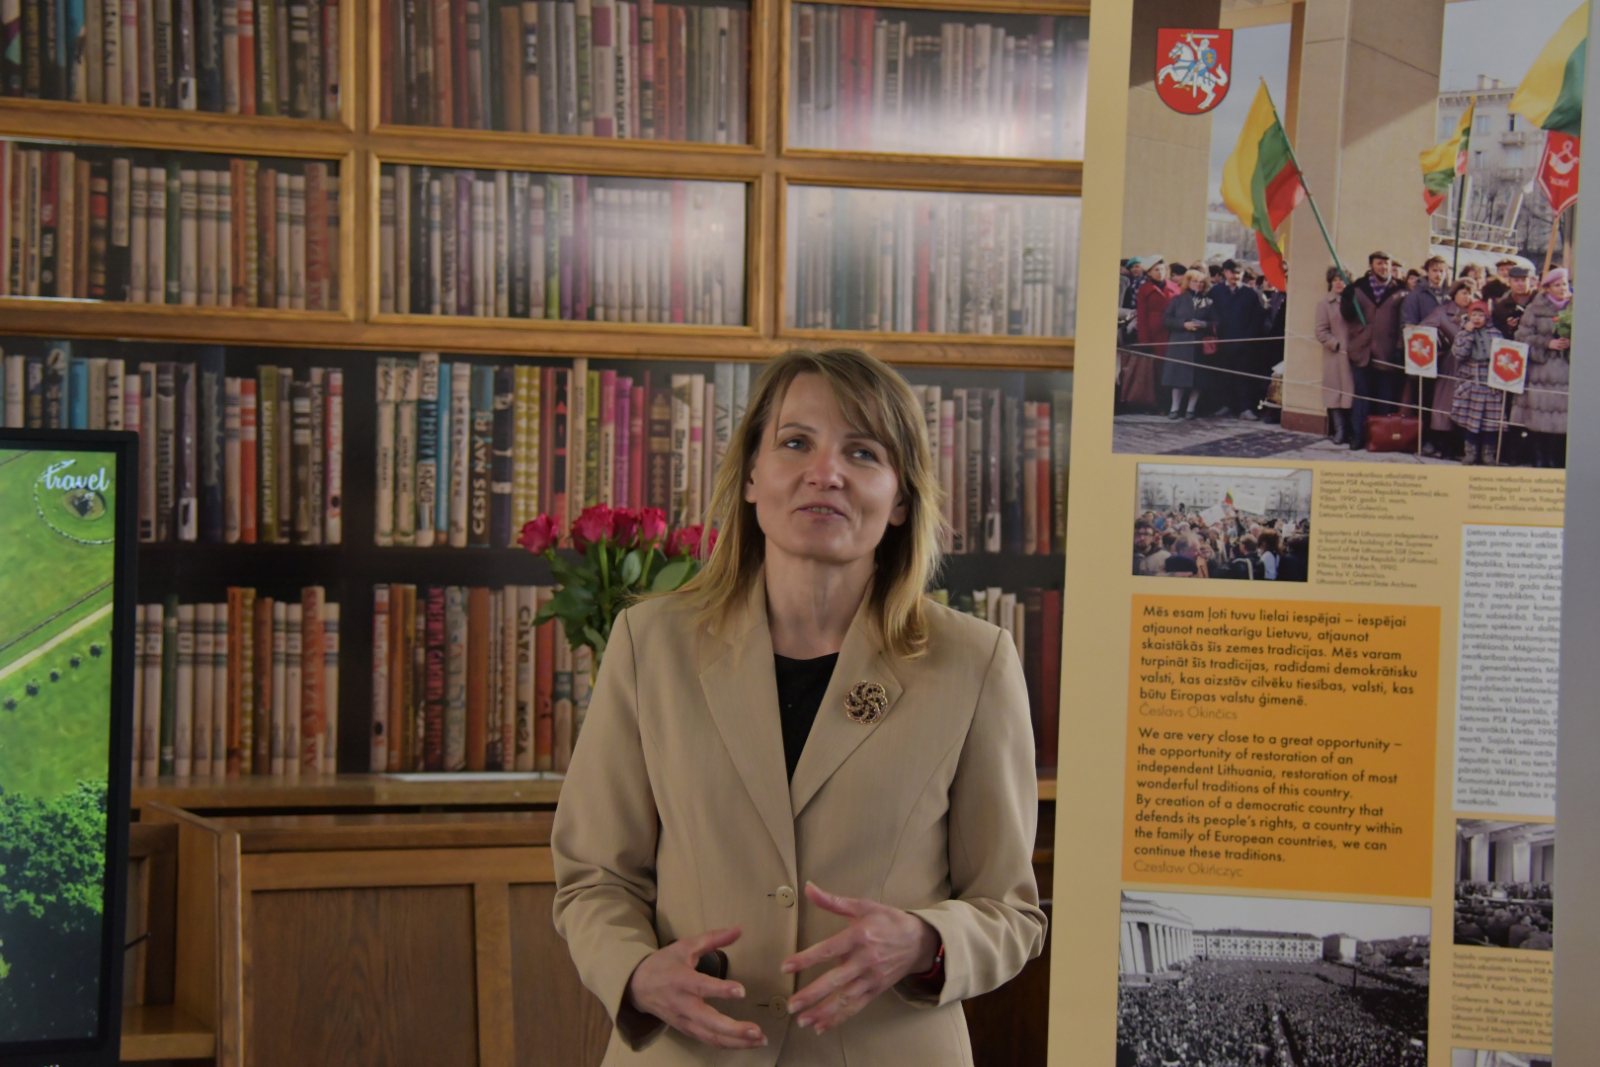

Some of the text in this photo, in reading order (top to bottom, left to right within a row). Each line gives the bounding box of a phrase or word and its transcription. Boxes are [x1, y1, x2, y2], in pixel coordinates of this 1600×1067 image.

[40, 459, 109, 491] travel
[1143, 606, 1169, 617] Mēs
[1172, 610, 1204, 618] esam
[1207, 609, 1226, 622] ļoti
[1230, 610, 1255, 620] tuvu
[1259, 611, 1288, 622] lielai
[1292, 612, 1340, 627] iespējai
[1357, 615, 1406, 630] iespējai
[1141, 623, 1369, 645] atjaunot neatkarīgu Lietuvu, atjaunot
[1141, 639, 1401, 660] skaistākās šīs zemes tradīcijas. Mēs varam
[1140, 656, 1417, 677] turpināt šīs tradīcijas, radīdami demokrātisku
[1139, 672, 1414, 696] valsti, kas aizstāv cilvēku tiesības, valsti, kas
[1139, 689, 1307, 709] būtu Eiropas valstu ģimenē.
[1137, 728, 1159, 739] We
[1163, 732, 1183, 740] are
[1187, 733, 1214, 745] very
[1217, 732, 1249, 743] close
[1252, 733, 1264, 744] to
[1280, 735, 1313, 749] great
[1316, 736, 1390, 753] opportunity
[1137, 745, 1353, 764] the opportunity of restoration of an
[1136, 761, 1397, 783] independent Lithuania, restoration of most
[1136, 778, 1352, 801] wonderful traditions of this country.
[1136, 795, 1383, 818] By creation of a democratic country that
[1135, 811, 1183, 823] defends
[1187, 814, 1200, 824] its
[1203, 814, 1256, 830] people's
[1259, 817, 1296, 832] rights,
[1313, 820, 1361, 835] country
[1365, 822, 1402, 834] within
[1134, 828, 1387, 851] the family of European countries, we can
[1133, 845, 1285, 861] continue these traditions.
